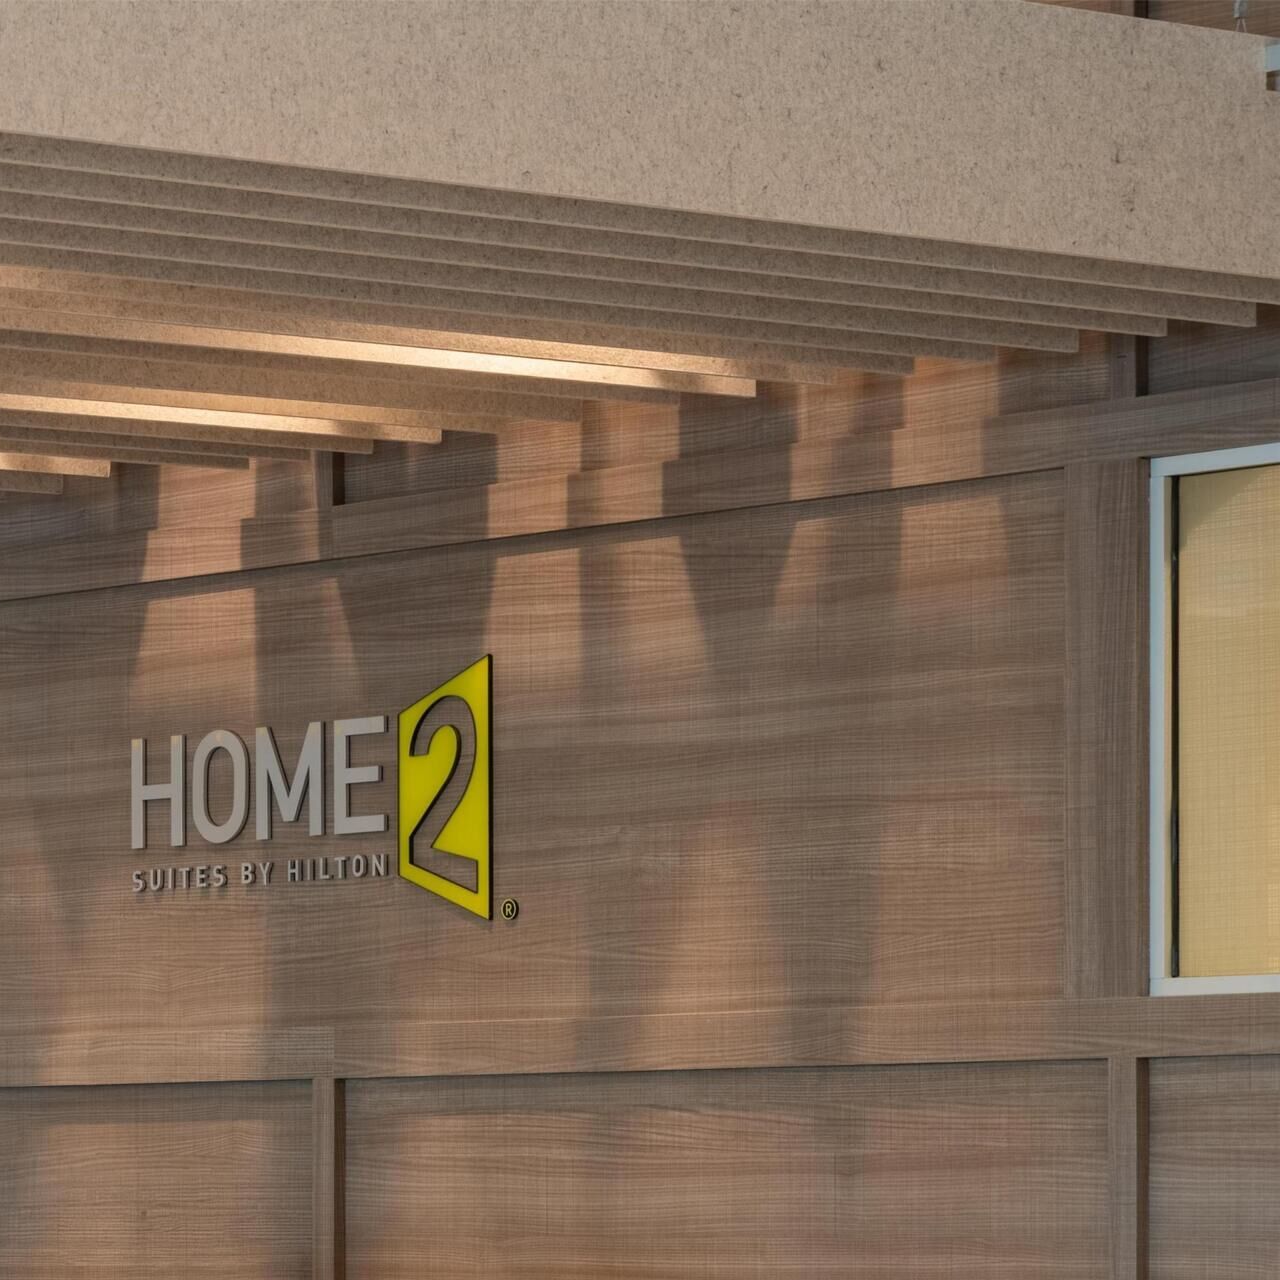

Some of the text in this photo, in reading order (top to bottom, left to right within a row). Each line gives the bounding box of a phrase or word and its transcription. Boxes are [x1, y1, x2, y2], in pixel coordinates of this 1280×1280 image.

[132, 853, 389, 893] SUITES BY HILTON
